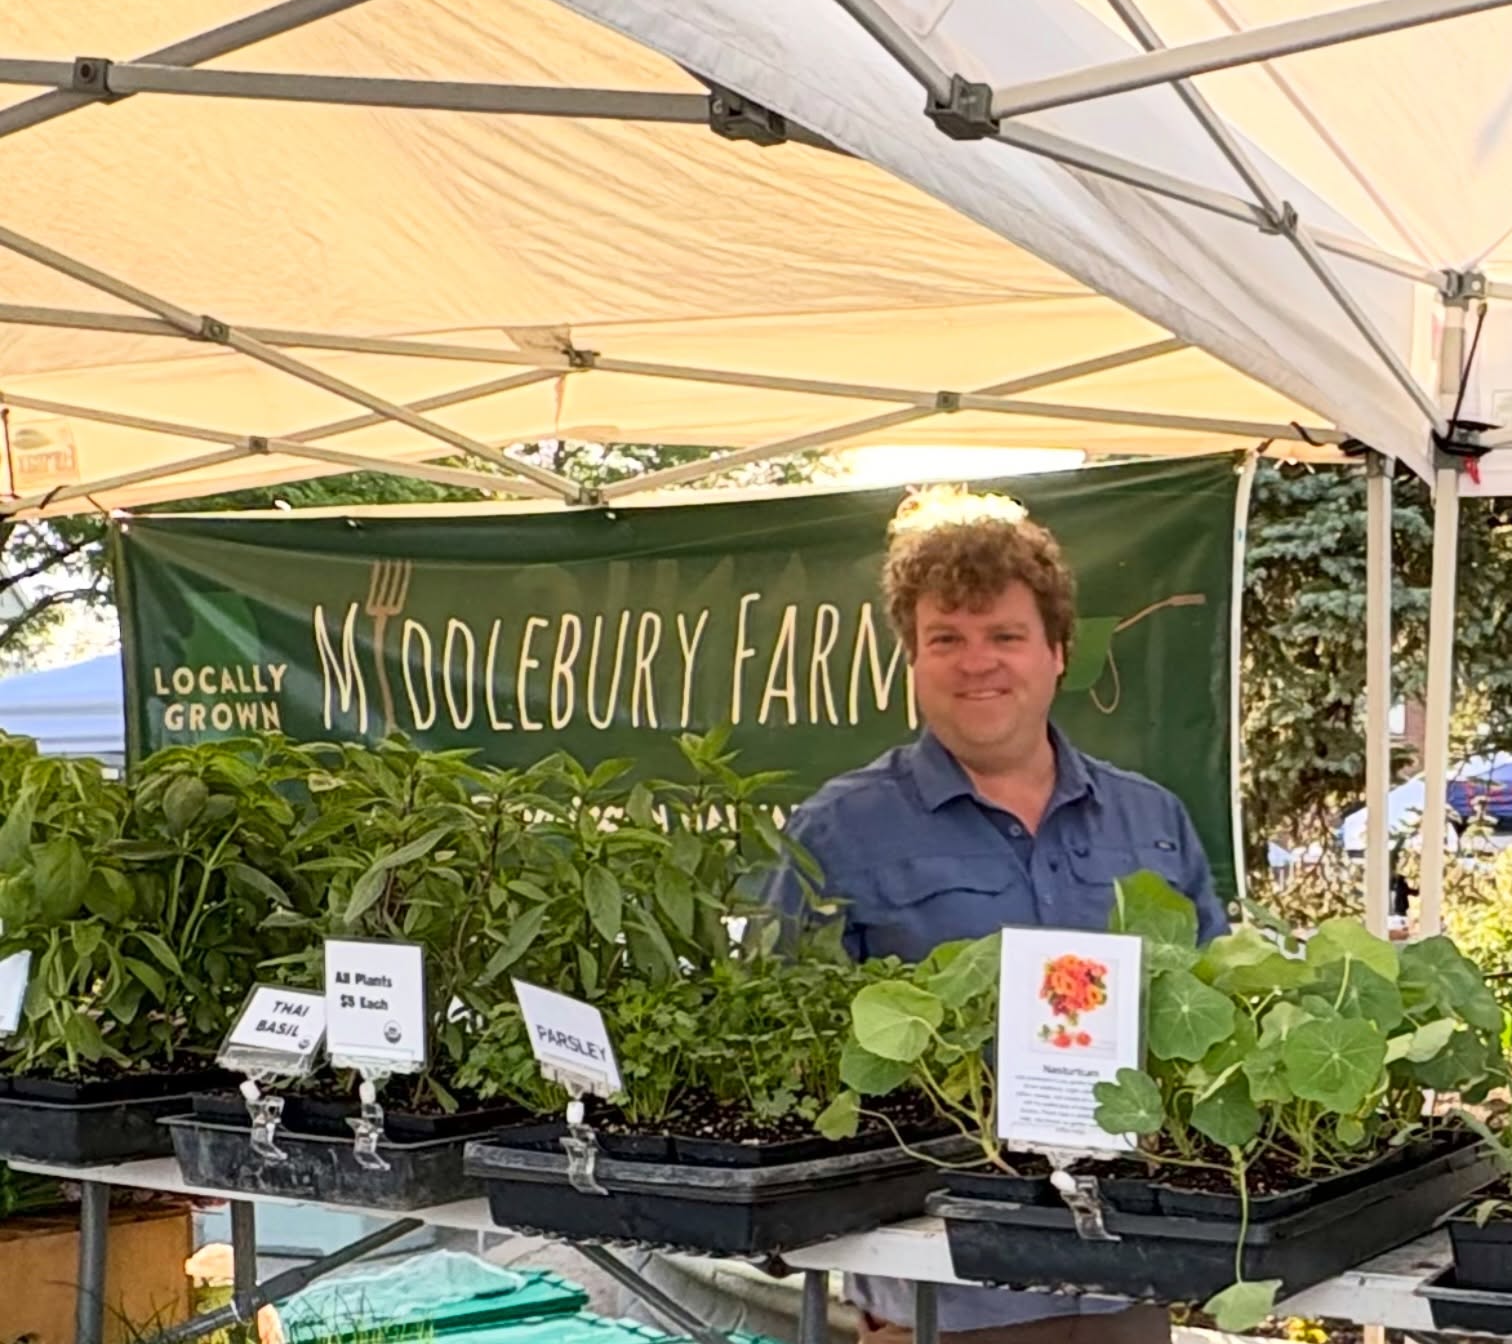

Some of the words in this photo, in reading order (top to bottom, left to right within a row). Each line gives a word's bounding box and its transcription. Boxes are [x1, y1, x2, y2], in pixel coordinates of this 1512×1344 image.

[155, 664, 287, 695] LOCALLY
[164, 702, 281, 731] GROWN
[335, 971, 350, 984] All
[355, 972, 392, 988] Plants
[272, 1001, 310, 1017] THAI
[360, 996, 389, 1010] Each
[256, 1019, 299, 1038] BASIL
[536, 1024, 606, 1062] PARSLEY
